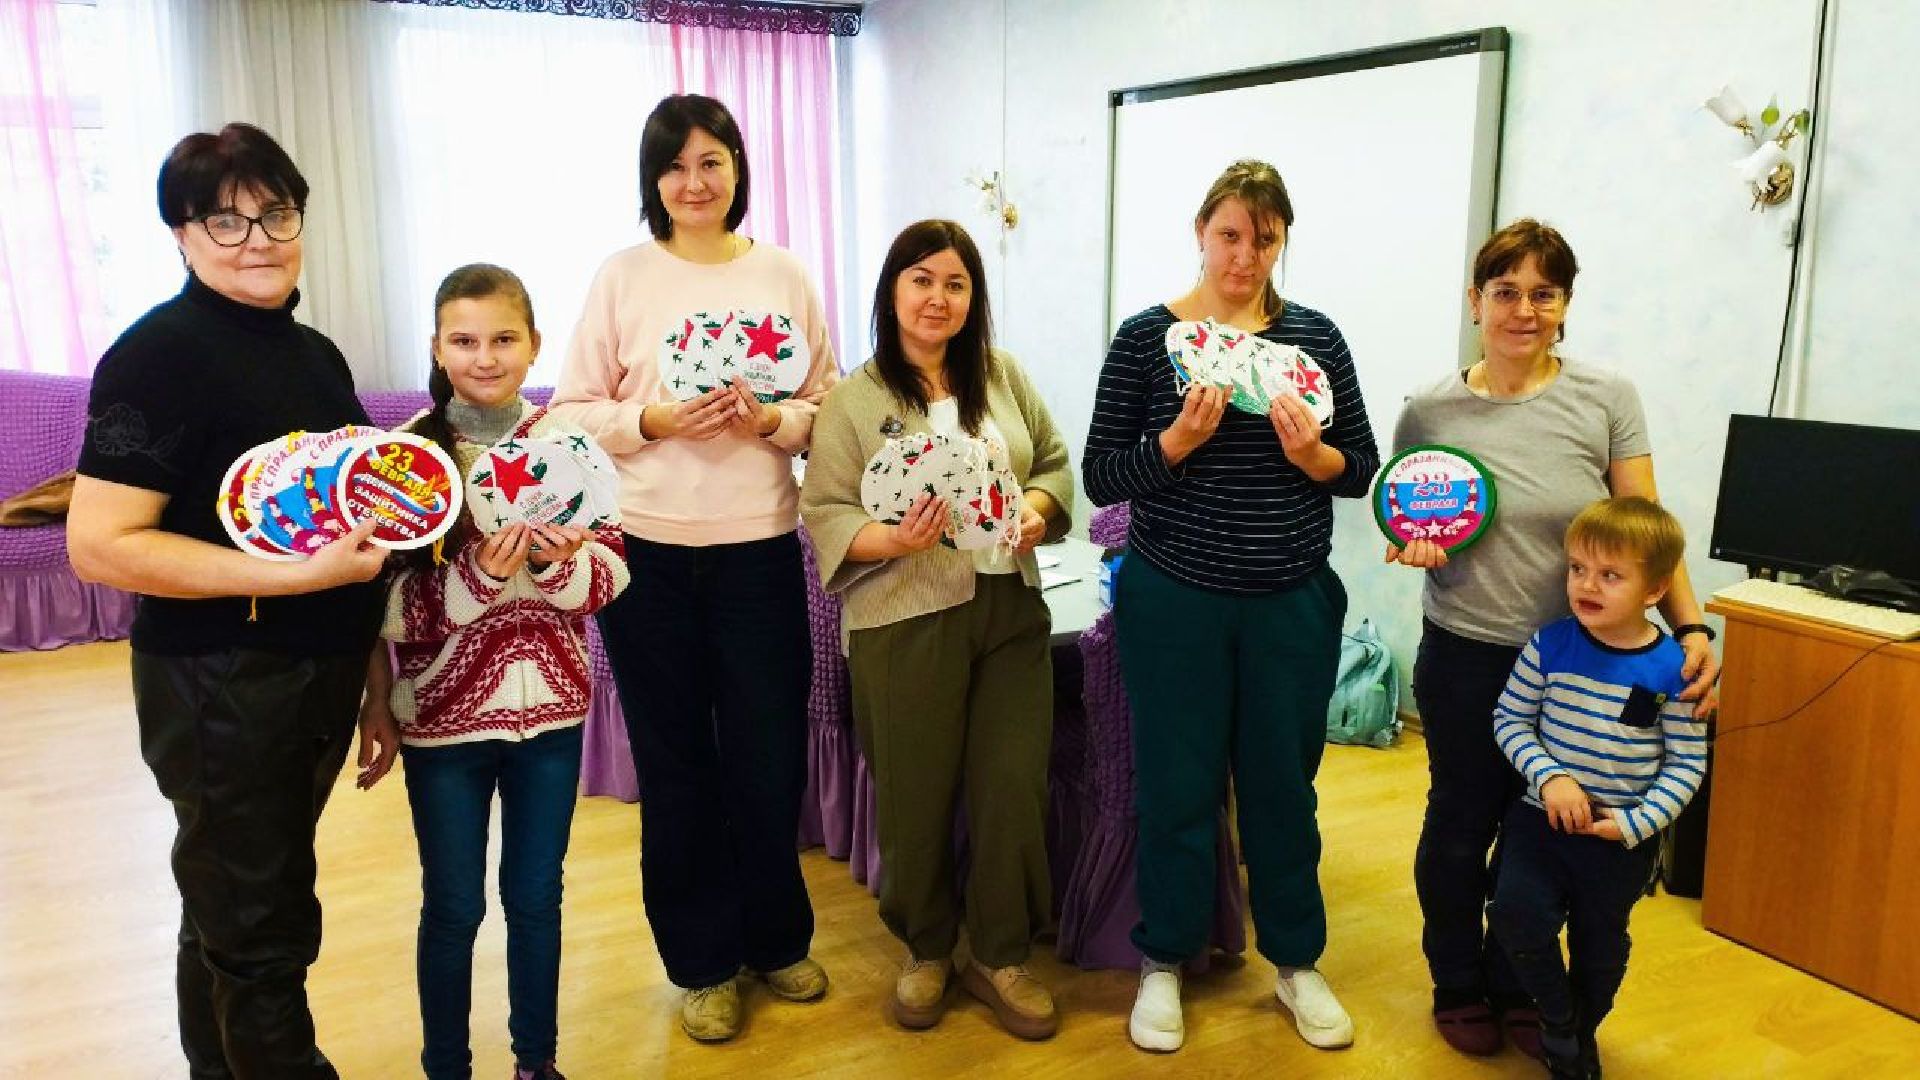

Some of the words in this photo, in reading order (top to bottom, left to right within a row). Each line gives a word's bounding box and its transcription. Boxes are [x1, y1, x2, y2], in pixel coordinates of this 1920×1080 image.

[383, 444, 415, 472] 23
[370, 460, 433, 496] ФЕВРАЛЯ
[1412, 473, 1453, 497] 23
[348, 498, 416, 539] ОТЕЧЕСТВА
[354, 486, 428, 530] ЗАЩИТНИКА
[1410, 499, 1459, 511] ФЕВРАЛЯ
